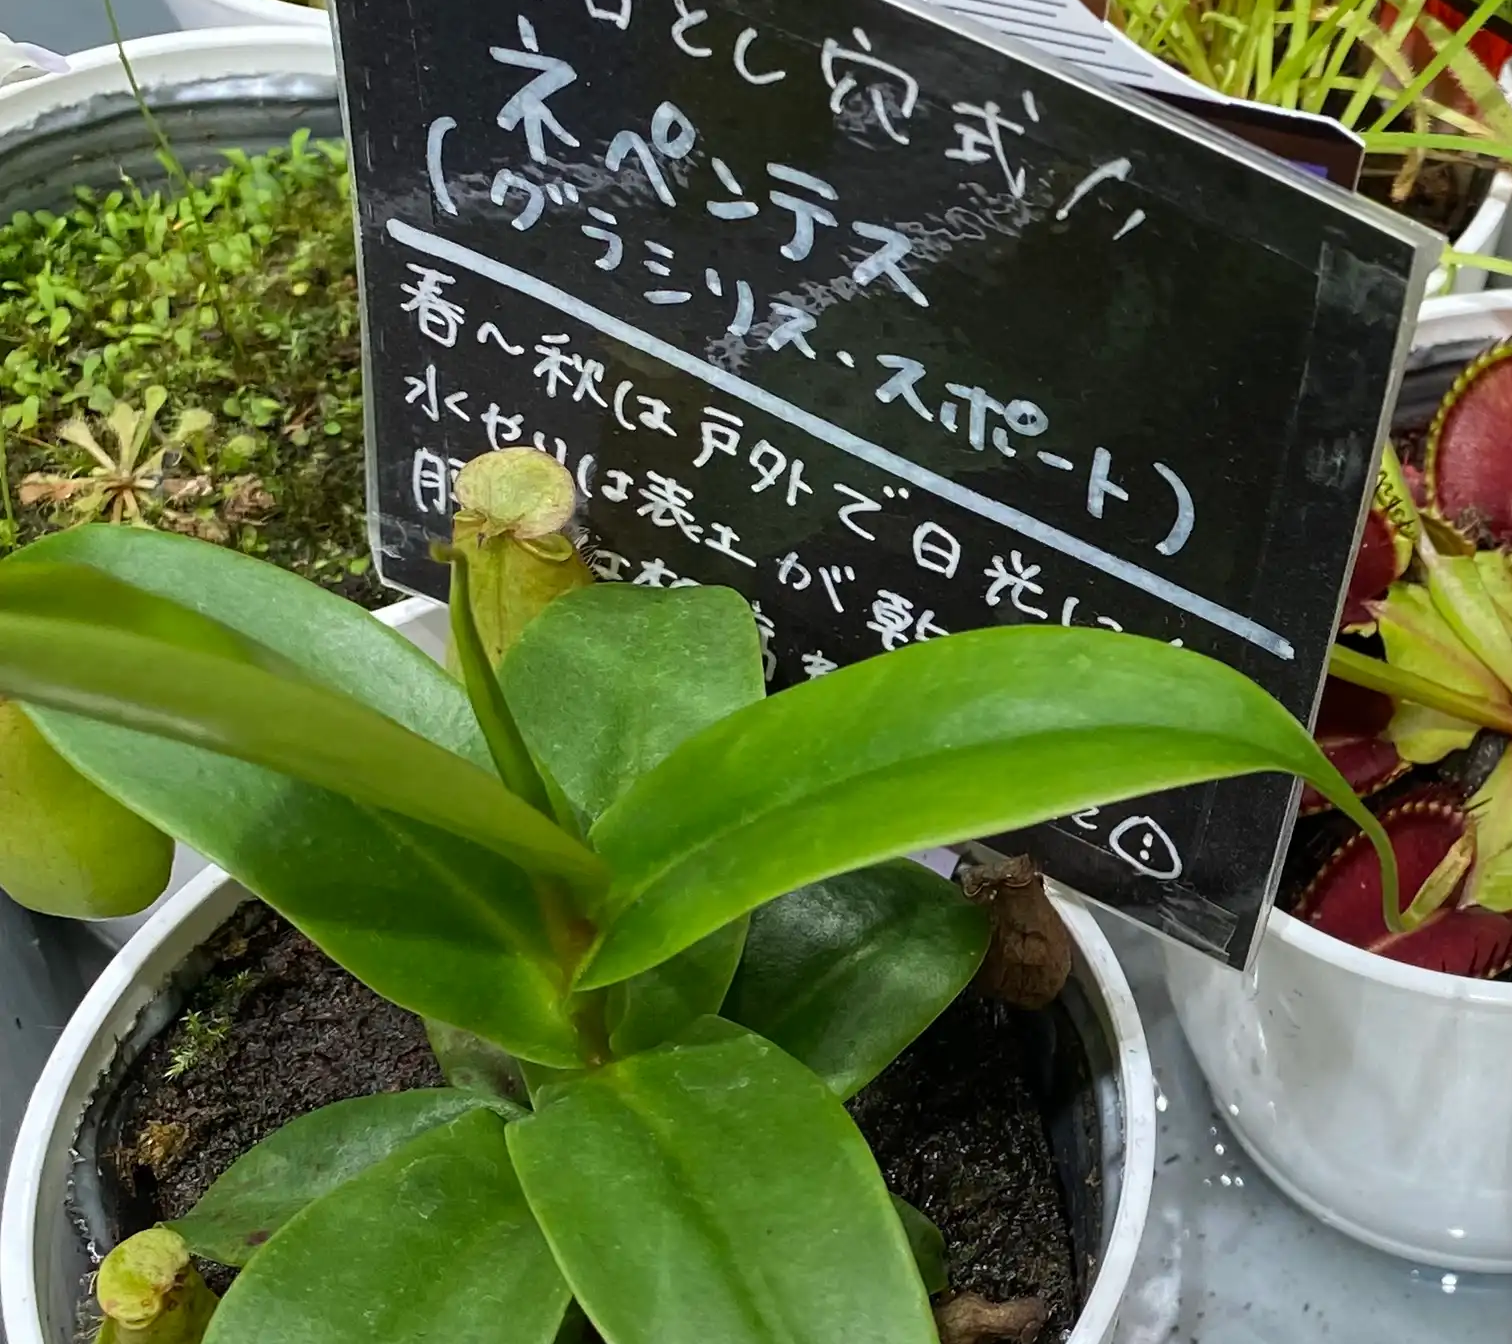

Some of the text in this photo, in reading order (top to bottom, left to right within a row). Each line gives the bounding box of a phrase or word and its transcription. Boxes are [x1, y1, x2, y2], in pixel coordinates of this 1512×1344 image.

[489, 16, 928, 307] ネペンテス
